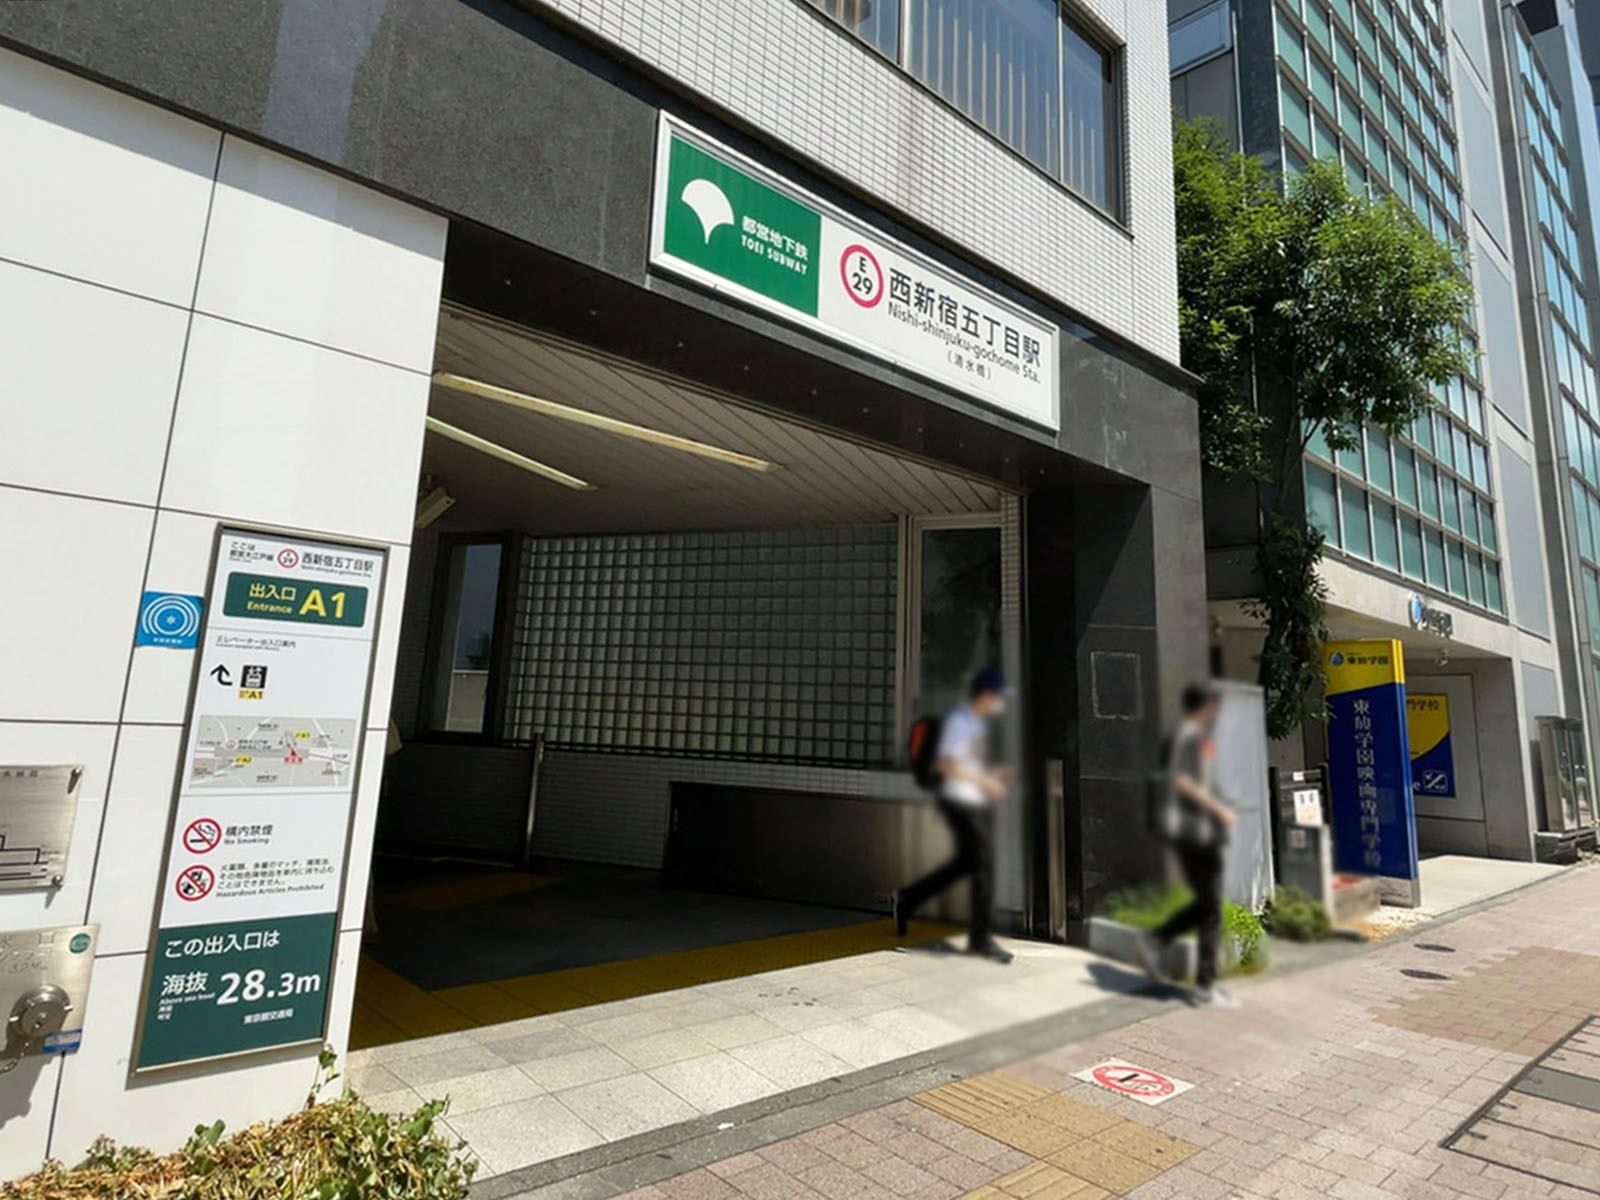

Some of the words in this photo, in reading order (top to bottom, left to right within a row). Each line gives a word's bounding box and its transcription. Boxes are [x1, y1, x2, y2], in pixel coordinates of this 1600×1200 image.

[742, 215, 808, 261] 都営地下鉄
[741, 235, 763, 255] TOEI
[767, 247, 807, 275] SUBWAY
[858, 257, 867, 273] E
[851, 273, 873, 295] 29
[889, 267, 1041, 368] 西新宿五丁目駅
[888, 302, 1020, 375] Nishi-shinjuku-gochome
[1022, 364, 1041, 384] Sta.
[302, 552, 375, 572] 西新宿五丁目駅
[246, 601, 294, 614] Entrance
[249, 583, 297, 600] 出入口
[299, 588, 346, 619] A1
[225, 824, 274, 837] 構内禁煙
[164, 930, 281, 959] この出入口は
[160, 970, 209, 997] 海抜
[215, 968, 322, 1006] 28.3m
